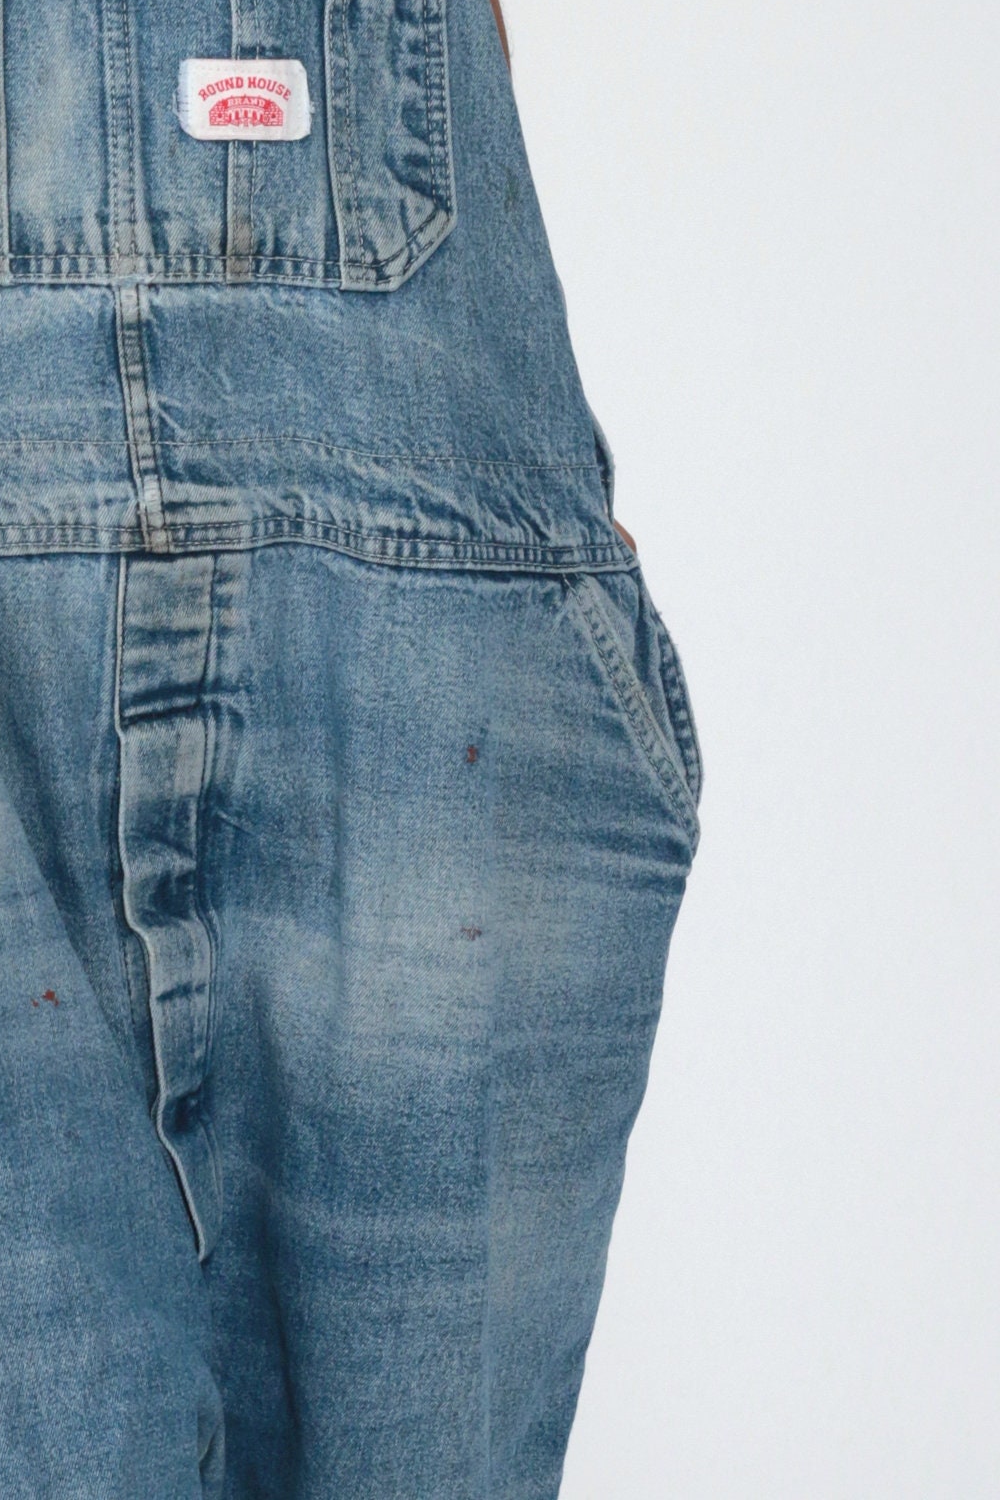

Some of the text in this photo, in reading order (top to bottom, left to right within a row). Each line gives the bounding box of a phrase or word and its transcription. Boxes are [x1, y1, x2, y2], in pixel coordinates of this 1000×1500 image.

[198, 76, 292, 101] ROUND HOUSE
[227, 98, 265, 107] BRAND
